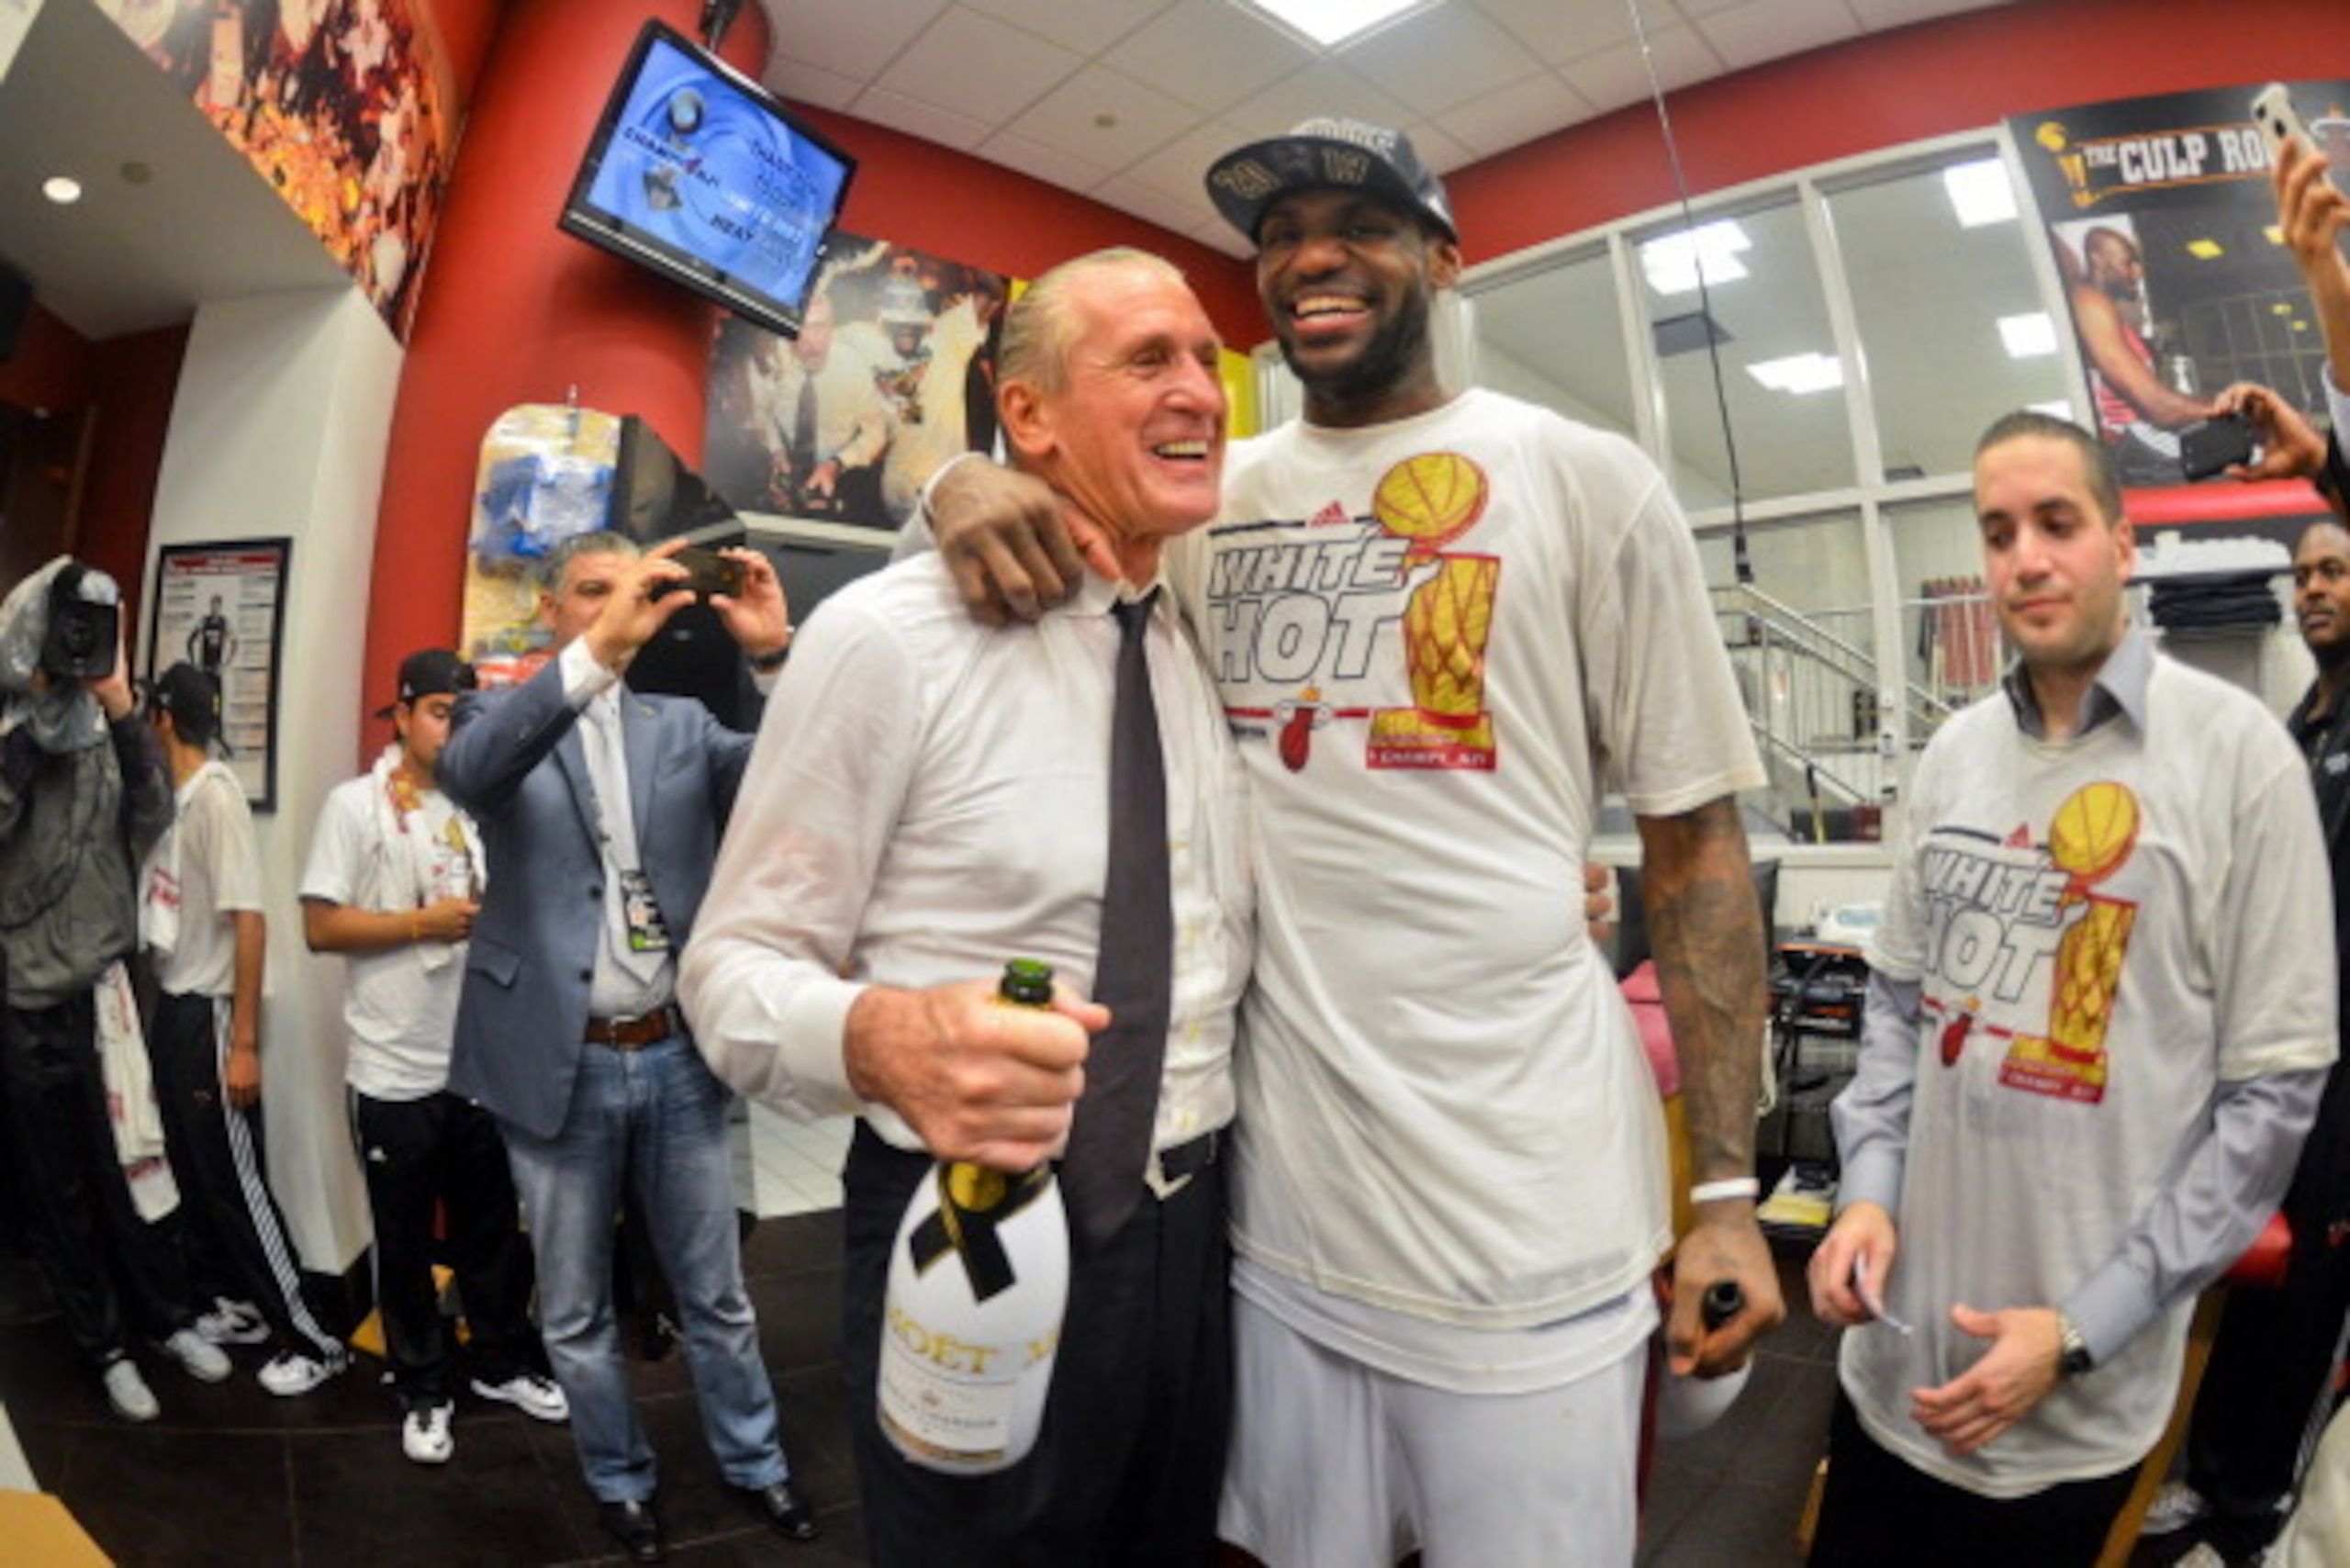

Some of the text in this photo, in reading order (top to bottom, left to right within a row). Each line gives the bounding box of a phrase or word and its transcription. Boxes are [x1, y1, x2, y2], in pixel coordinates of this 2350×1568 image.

[2084, 144, 2118, 167] THE
[2119, 133, 2209, 184] CULP
[1207, 535, 1414, 597] WHITE
[1208, 588, 1418, 683] HOT
